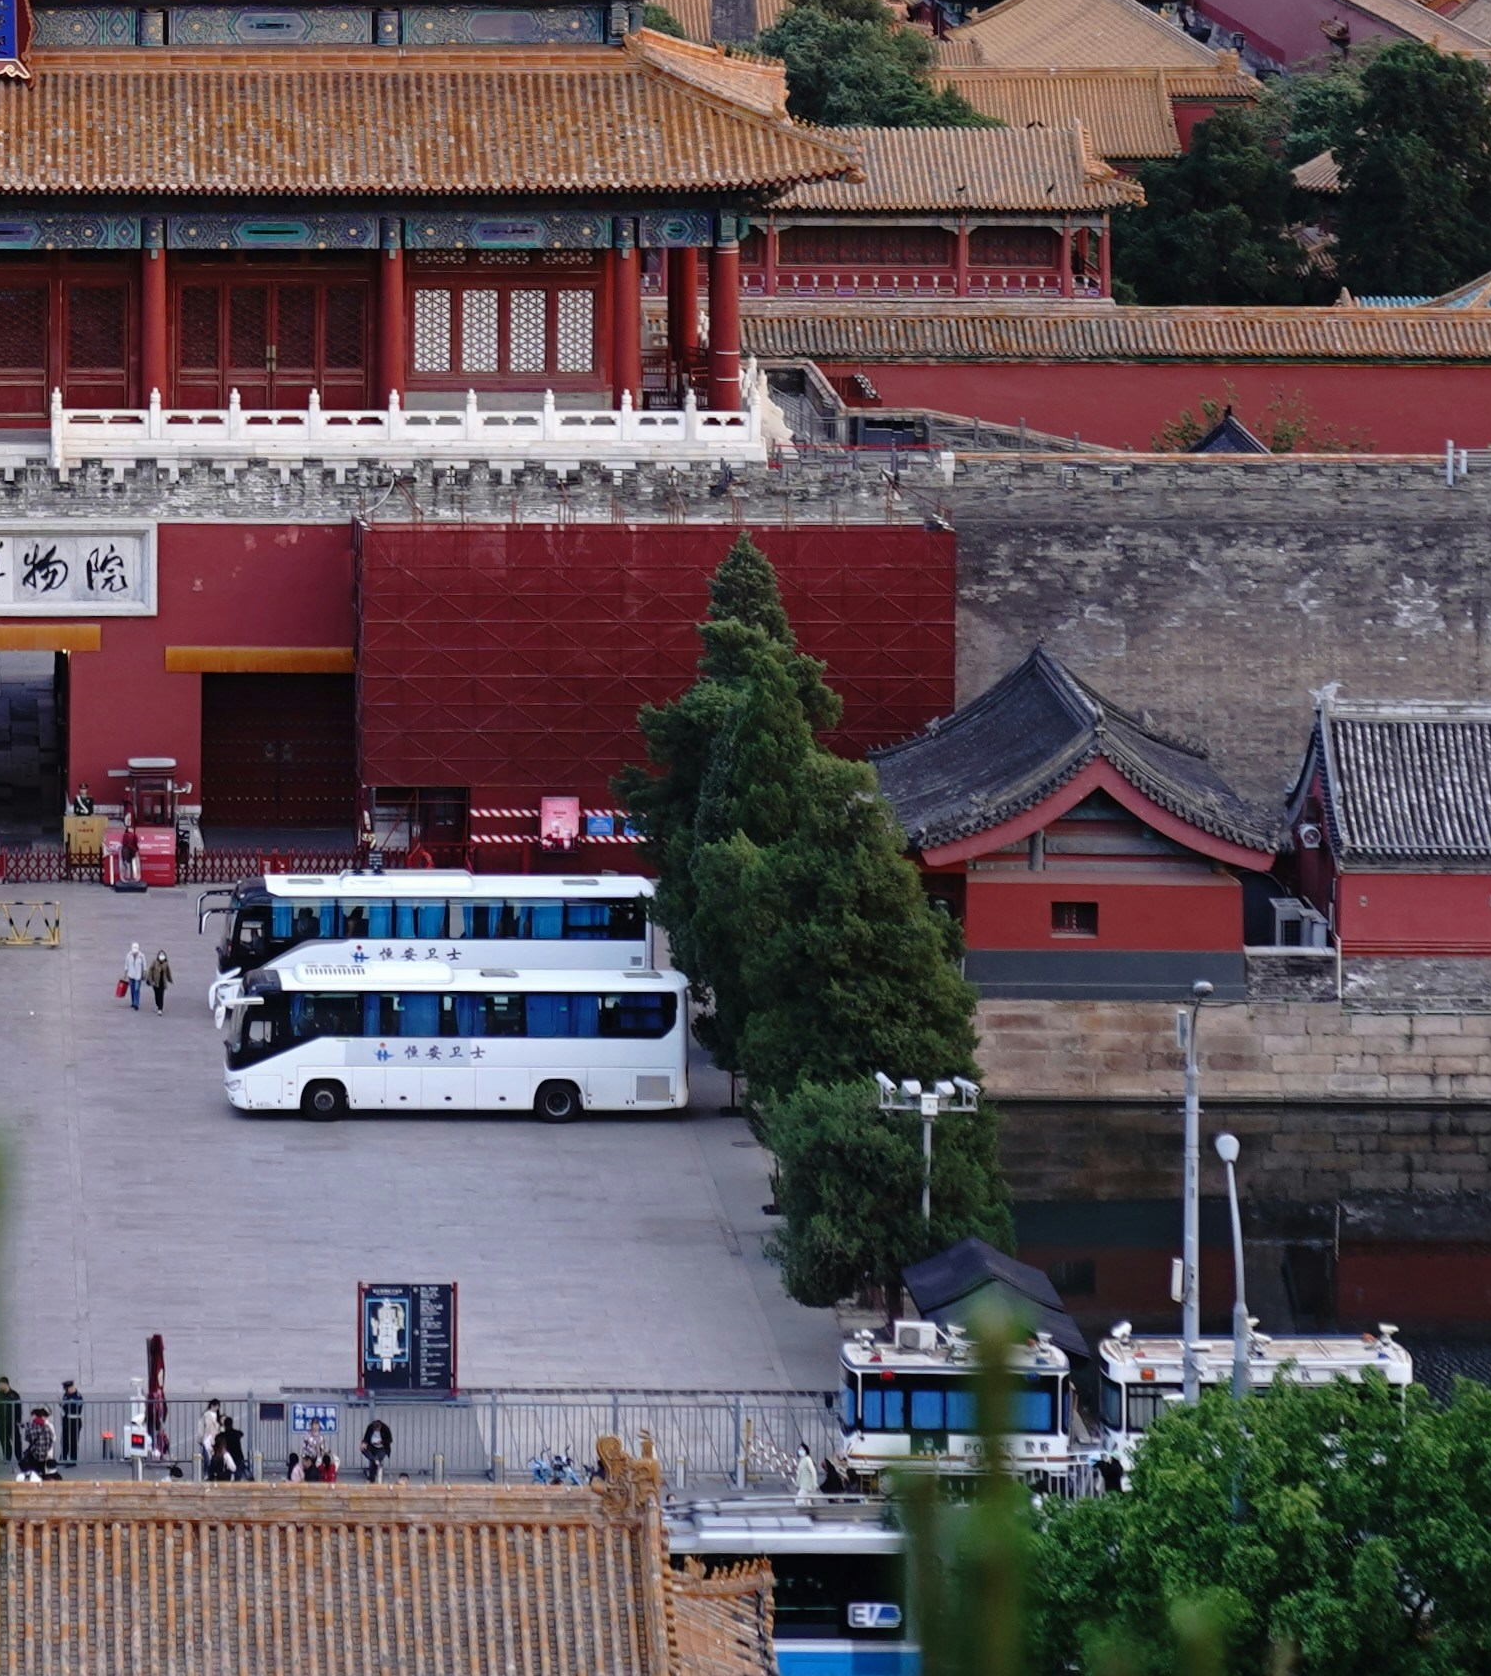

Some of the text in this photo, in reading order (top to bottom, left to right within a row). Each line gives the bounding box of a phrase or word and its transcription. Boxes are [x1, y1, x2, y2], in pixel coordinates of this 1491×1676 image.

[379, 947, 462, 961] 恒安卫士
[404, 1045, 486, 1060] 恒安卫士
[964, 1442, 1014, 1455] POCE
